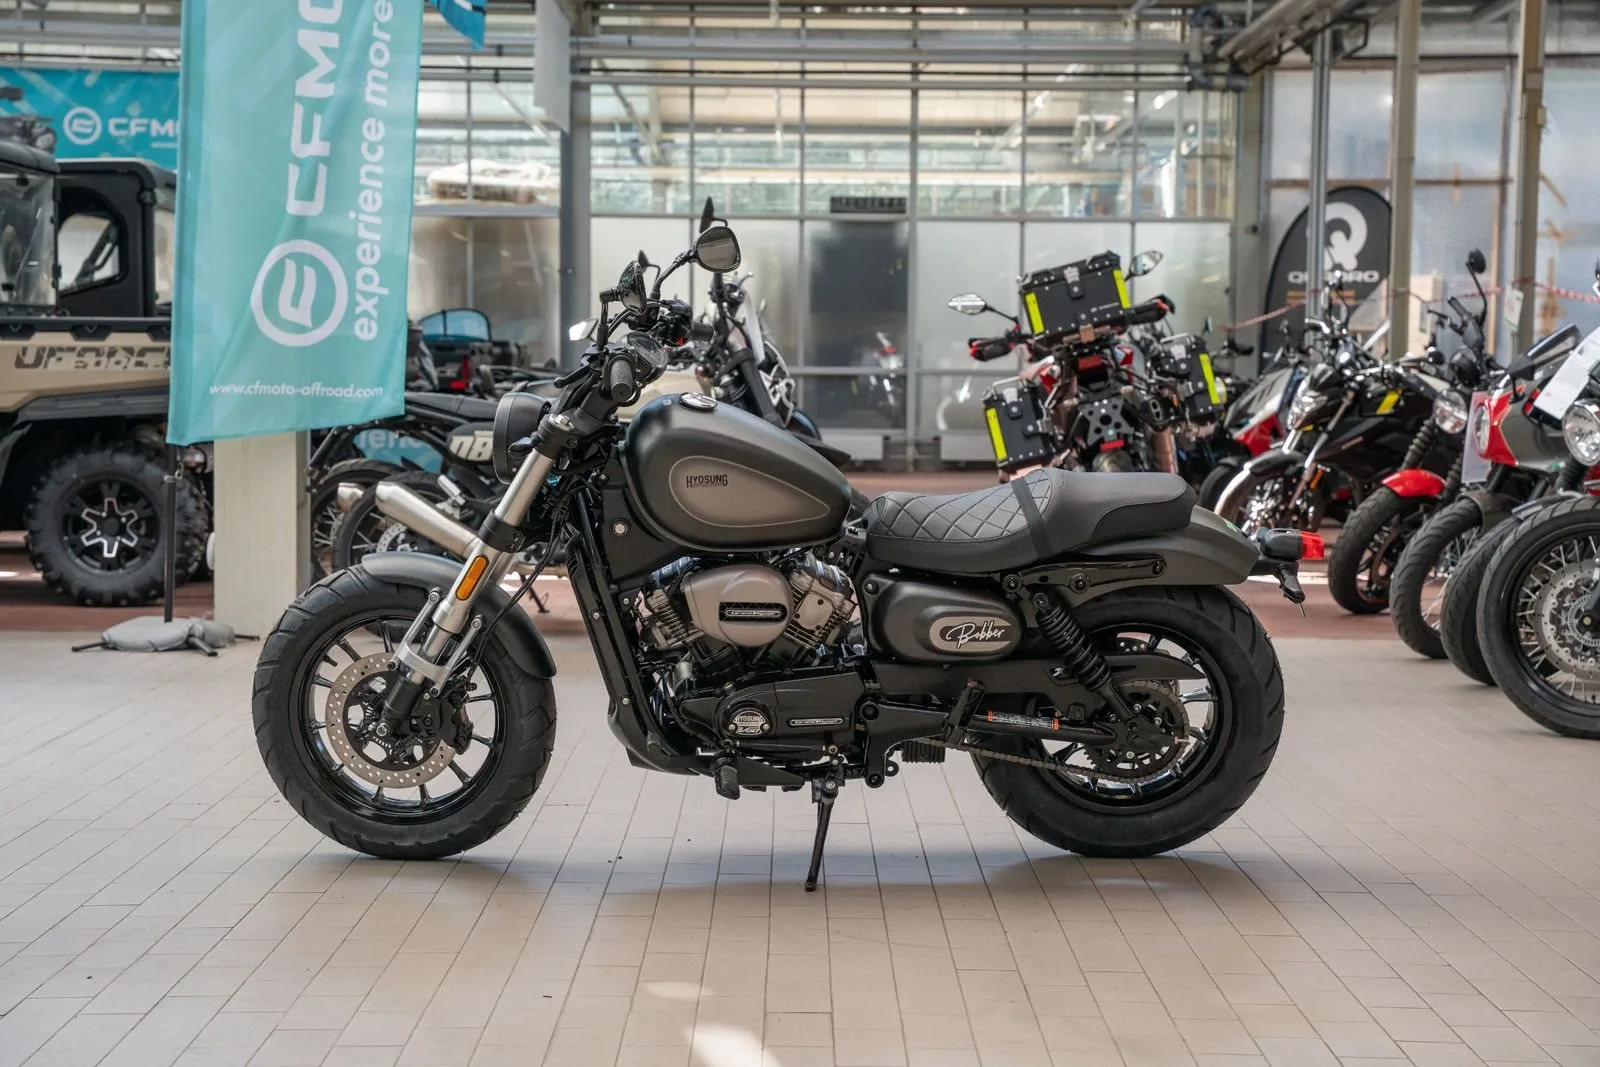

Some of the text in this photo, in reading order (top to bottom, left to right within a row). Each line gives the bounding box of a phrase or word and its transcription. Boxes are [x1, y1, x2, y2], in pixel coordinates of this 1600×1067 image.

[108, 117, 180, 137] CFM
[353, 0, 394, 341] experience more
[209, 380, 383, 398] www.cfmoto-offroad.com
[686, 474, 728, 488] HYOSUNG
[946, 621, 1005, 649] Bobber
